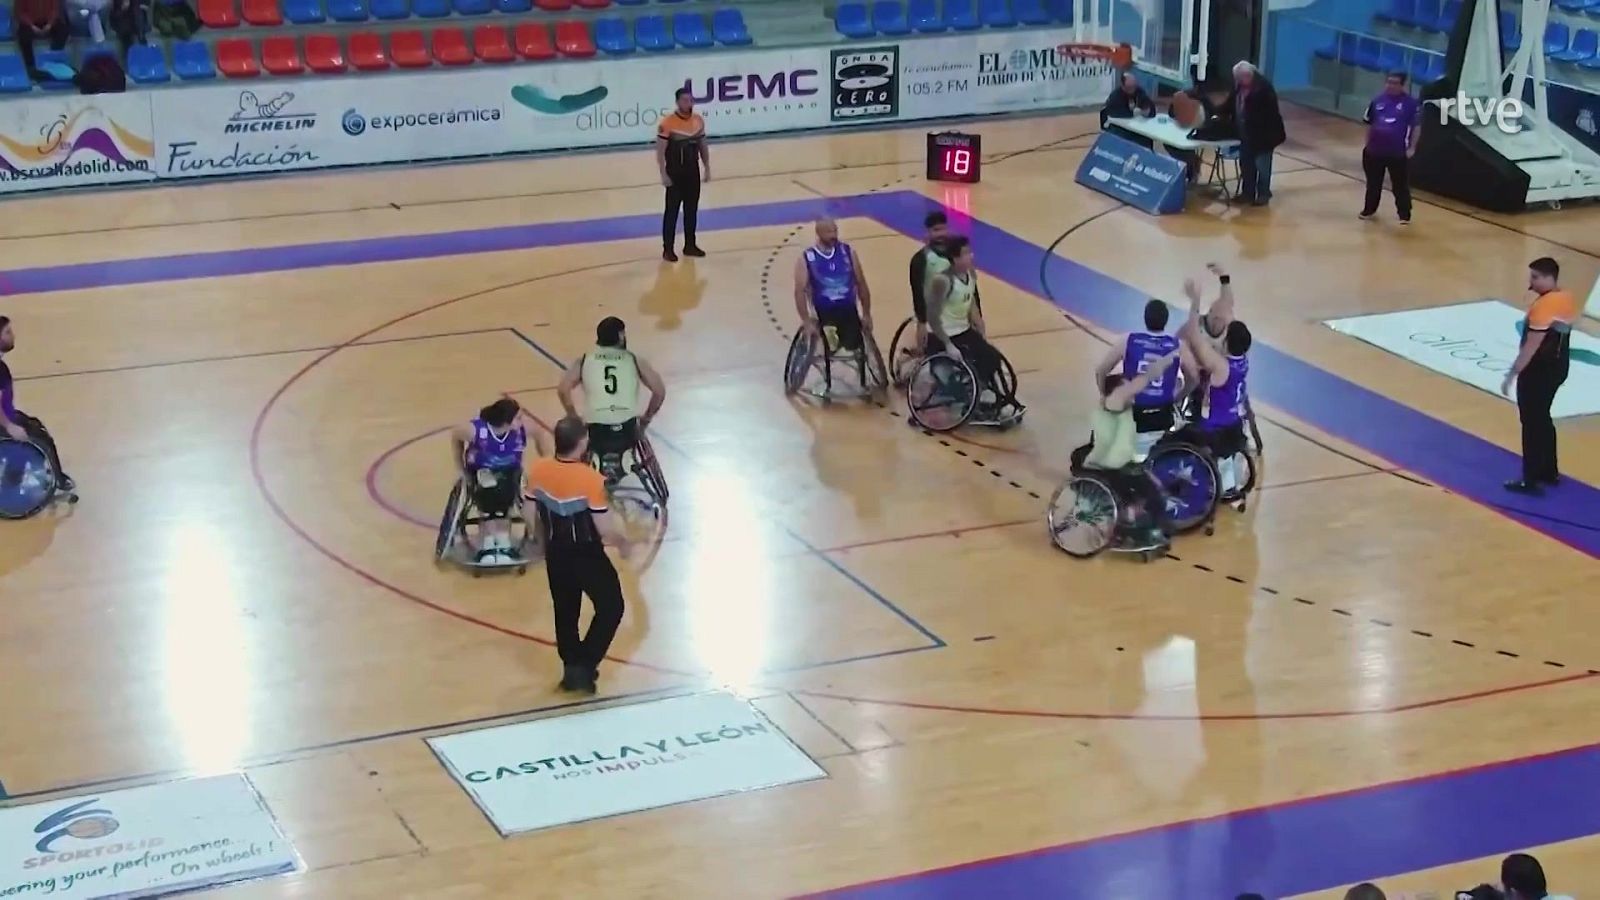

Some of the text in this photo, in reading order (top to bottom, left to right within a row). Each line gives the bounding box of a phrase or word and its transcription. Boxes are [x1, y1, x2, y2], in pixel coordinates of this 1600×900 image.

[841, 54, 889, 65] ONDA
[979, 53, 1007, 73] EL
[684, 69, 819, 105] UEMC
[907, 79, 968, 95] 105.2 FM
[978, 73, 1018, 87] DIARIO
[836, 90, 888, 105] CERO
[371, 104, 501, 132] expocerámica
[702, 101, 819, 118] NIVERSIDAD
[224, 118, 316, 135] MICHELIN
[167, 140, 320, 173] Fundación
[945, 149, 970, 175] 18
[604, 365, 617, 394] 5
[465, 722, 770, 783] CASTILLA Y LEÓN
[553, 768, 592, 781] NOS
[23, 836, 164, 870] SPORTOLID
[170, 861, 200, 877] On
[0, 877, 56, 899] ering
[61, 865, 107, 888] your
